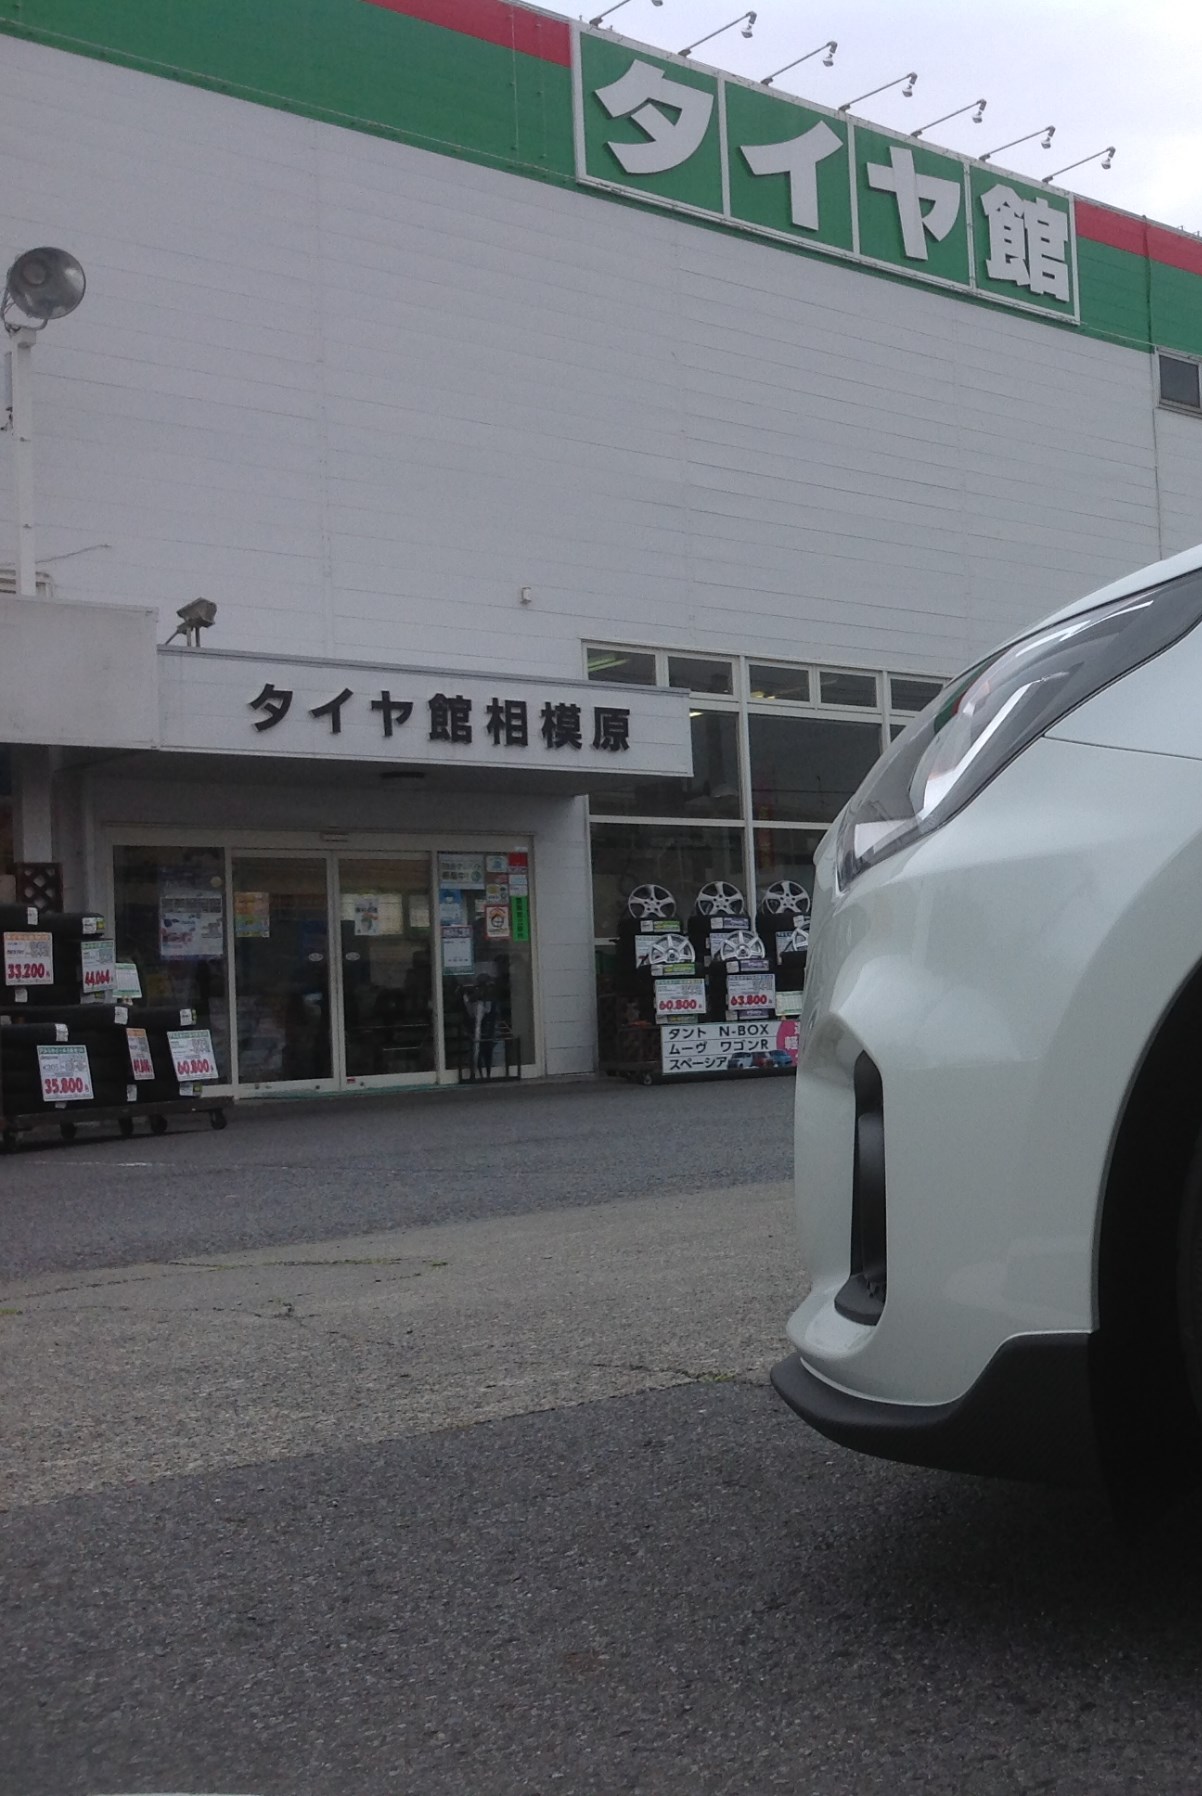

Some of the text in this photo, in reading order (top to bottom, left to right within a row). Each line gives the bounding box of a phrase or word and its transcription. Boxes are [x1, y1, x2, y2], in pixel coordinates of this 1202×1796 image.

[595, 58, 1070, 302] タイヤ館
[248, 683, 631, 752] タイヤ館相模原
[668, 1024, 769, 1040] タント N-BOX
[669, 1040, 769, 1055] ムーヴ ワゴンR
[670, 1056, 727, 1070] スペーシア
